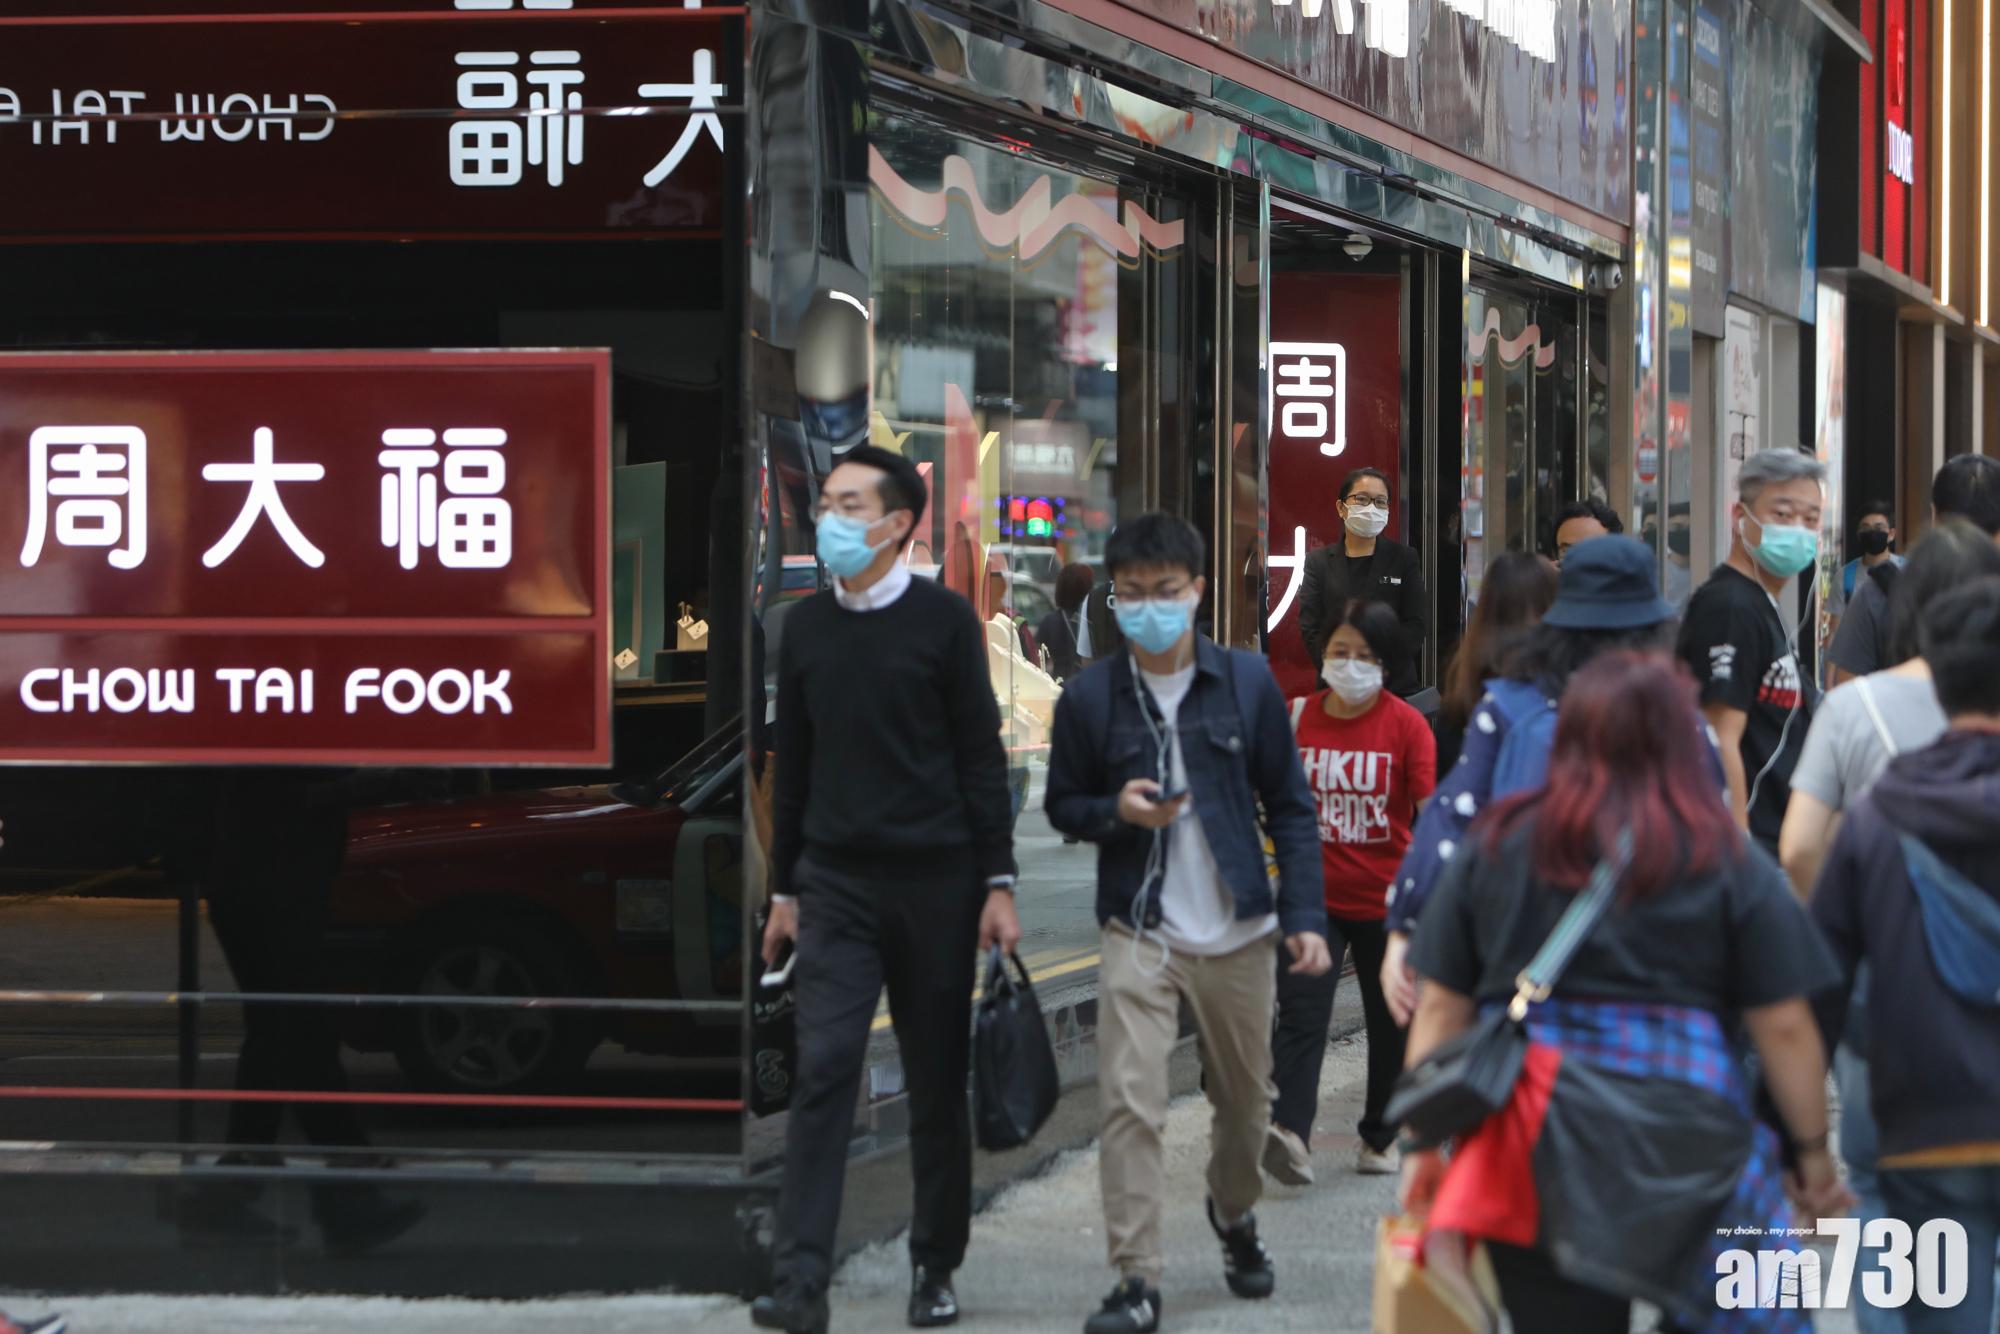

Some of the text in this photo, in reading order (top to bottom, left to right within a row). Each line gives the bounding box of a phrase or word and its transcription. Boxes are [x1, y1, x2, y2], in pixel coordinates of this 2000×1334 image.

[20, 425, 512, 569] 周大福
[20, 667, 513, 714] CHOW TAI FOOK
[1304, 747, 1378, 791] HKU
